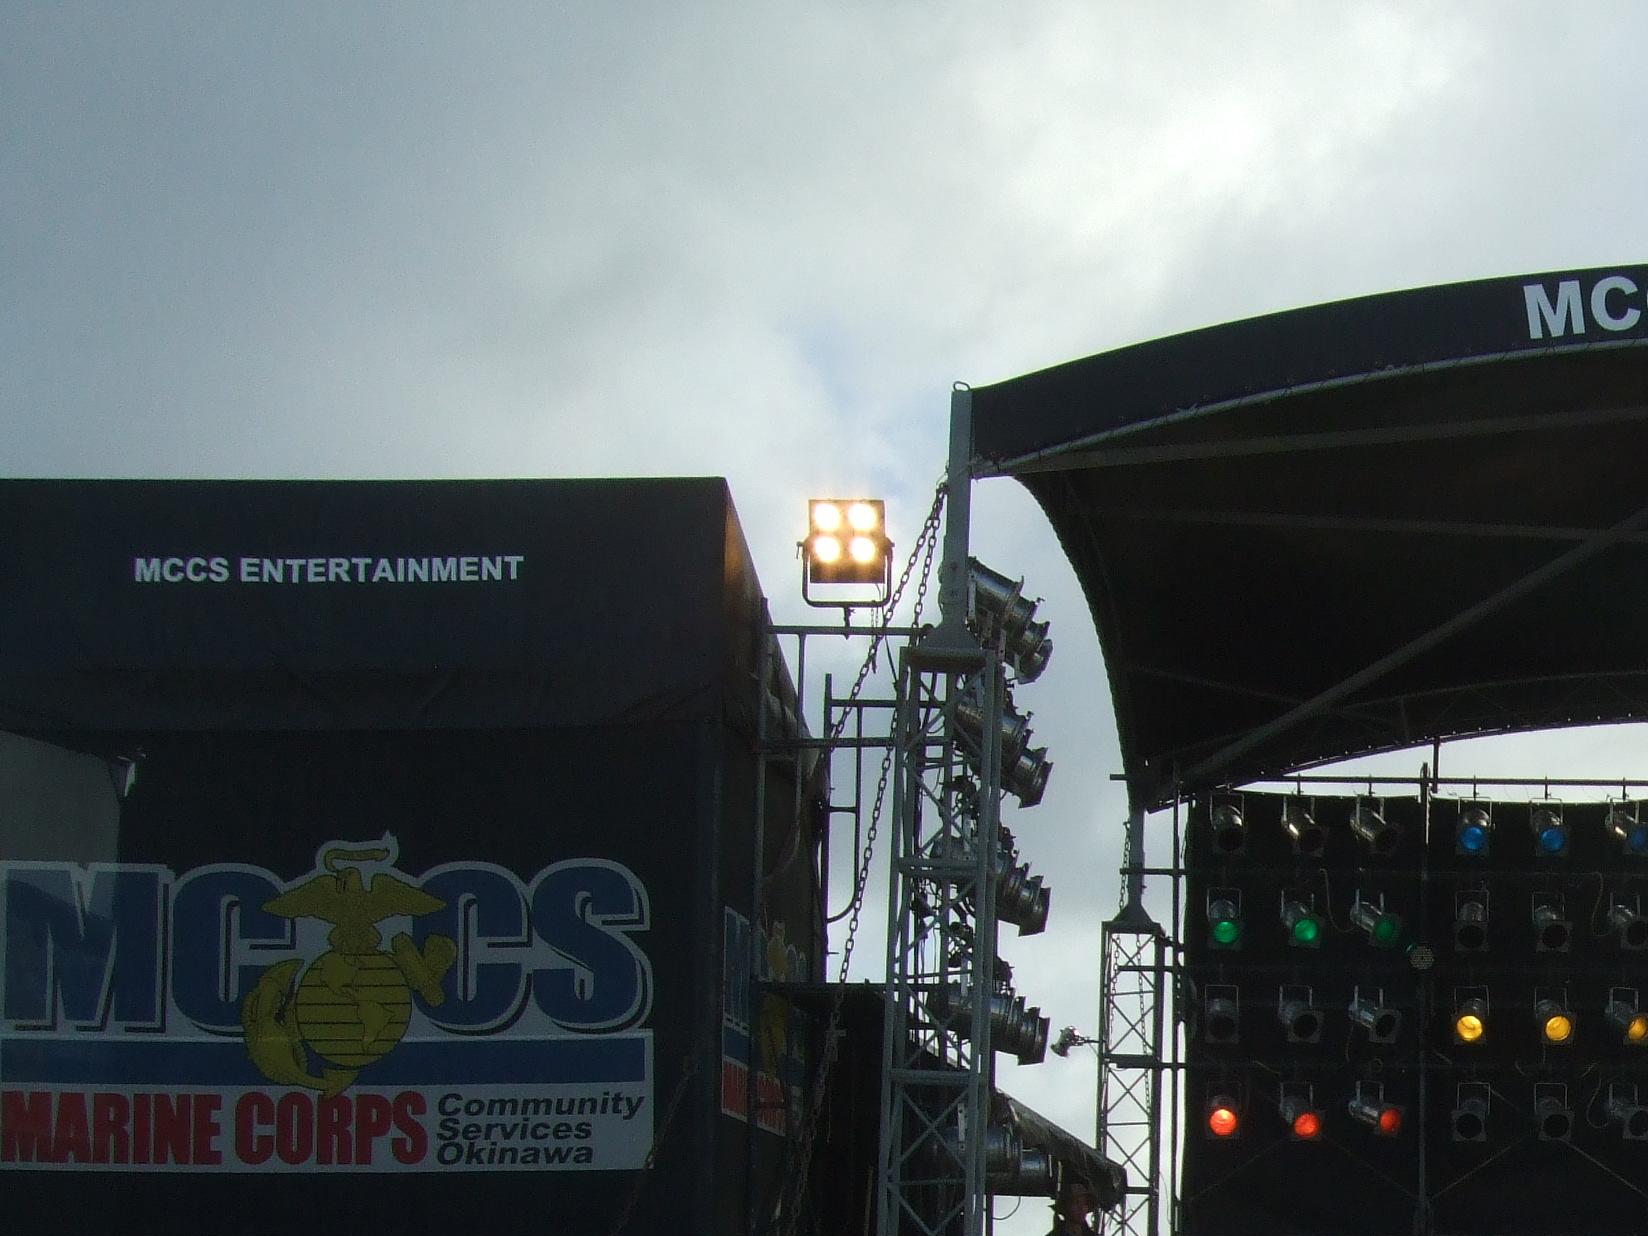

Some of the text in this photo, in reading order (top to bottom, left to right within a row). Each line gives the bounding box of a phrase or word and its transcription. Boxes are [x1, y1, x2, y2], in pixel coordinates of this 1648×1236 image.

[134, 555, 525, 583] MCCS ENTERTAINMENT
[0, 858, 651, 1036] MCCS
[437, 1092, 645, 1120] Community
[0, 1091, 428, 1165] MARINE CORPS
[437, 1117, 593, 1142] Services
[437, 1141, 594, 1165] Okinawa
